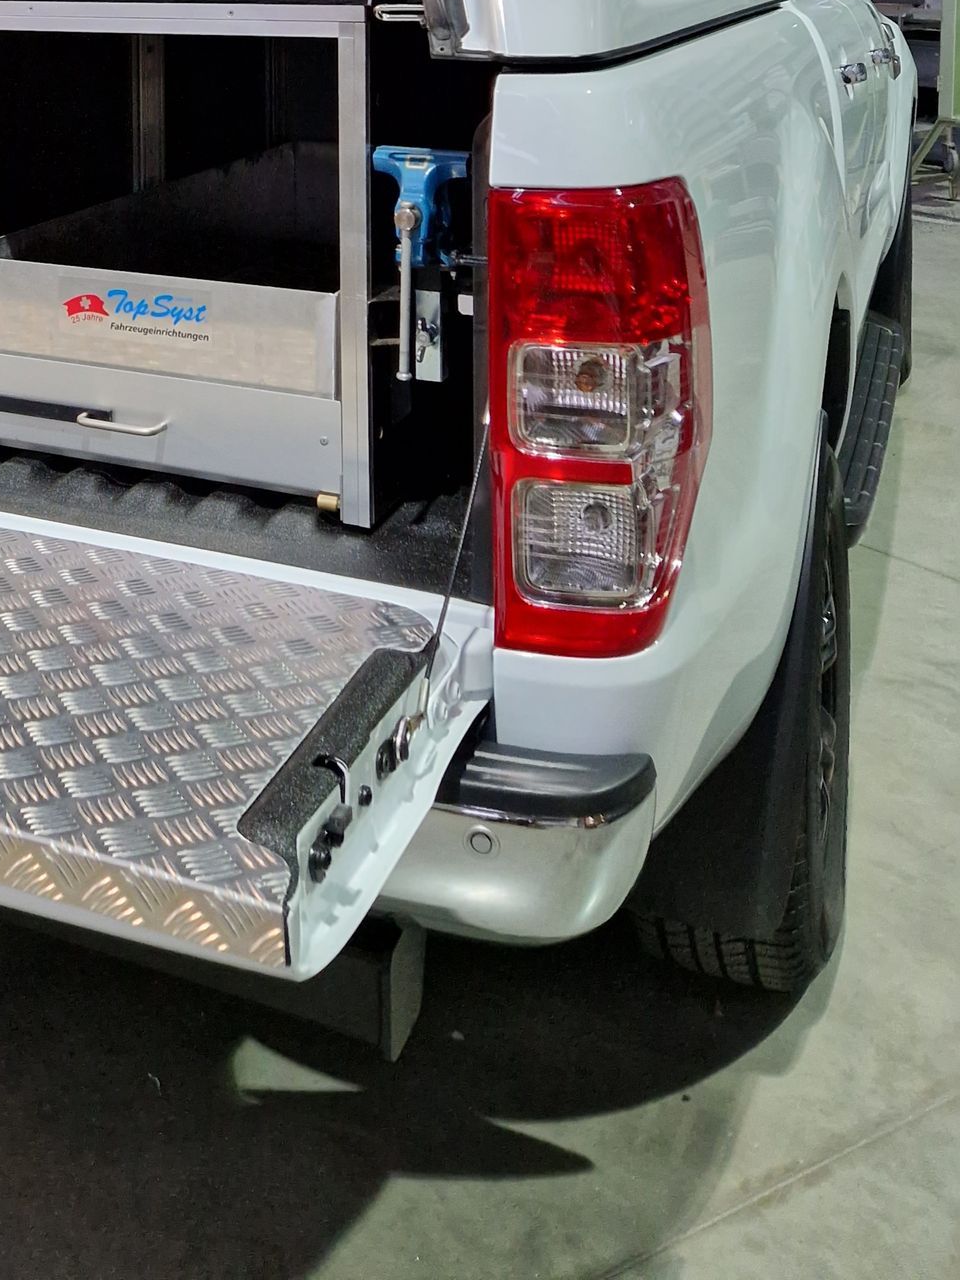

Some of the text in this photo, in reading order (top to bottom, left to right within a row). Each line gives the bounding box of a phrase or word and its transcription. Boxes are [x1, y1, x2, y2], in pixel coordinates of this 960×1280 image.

[107, 289, 207, 325] TopSyst
[81, 313, 103, 322] Jahre
[110, 322, 210, 342] Fahrzeugeinrichtungen
